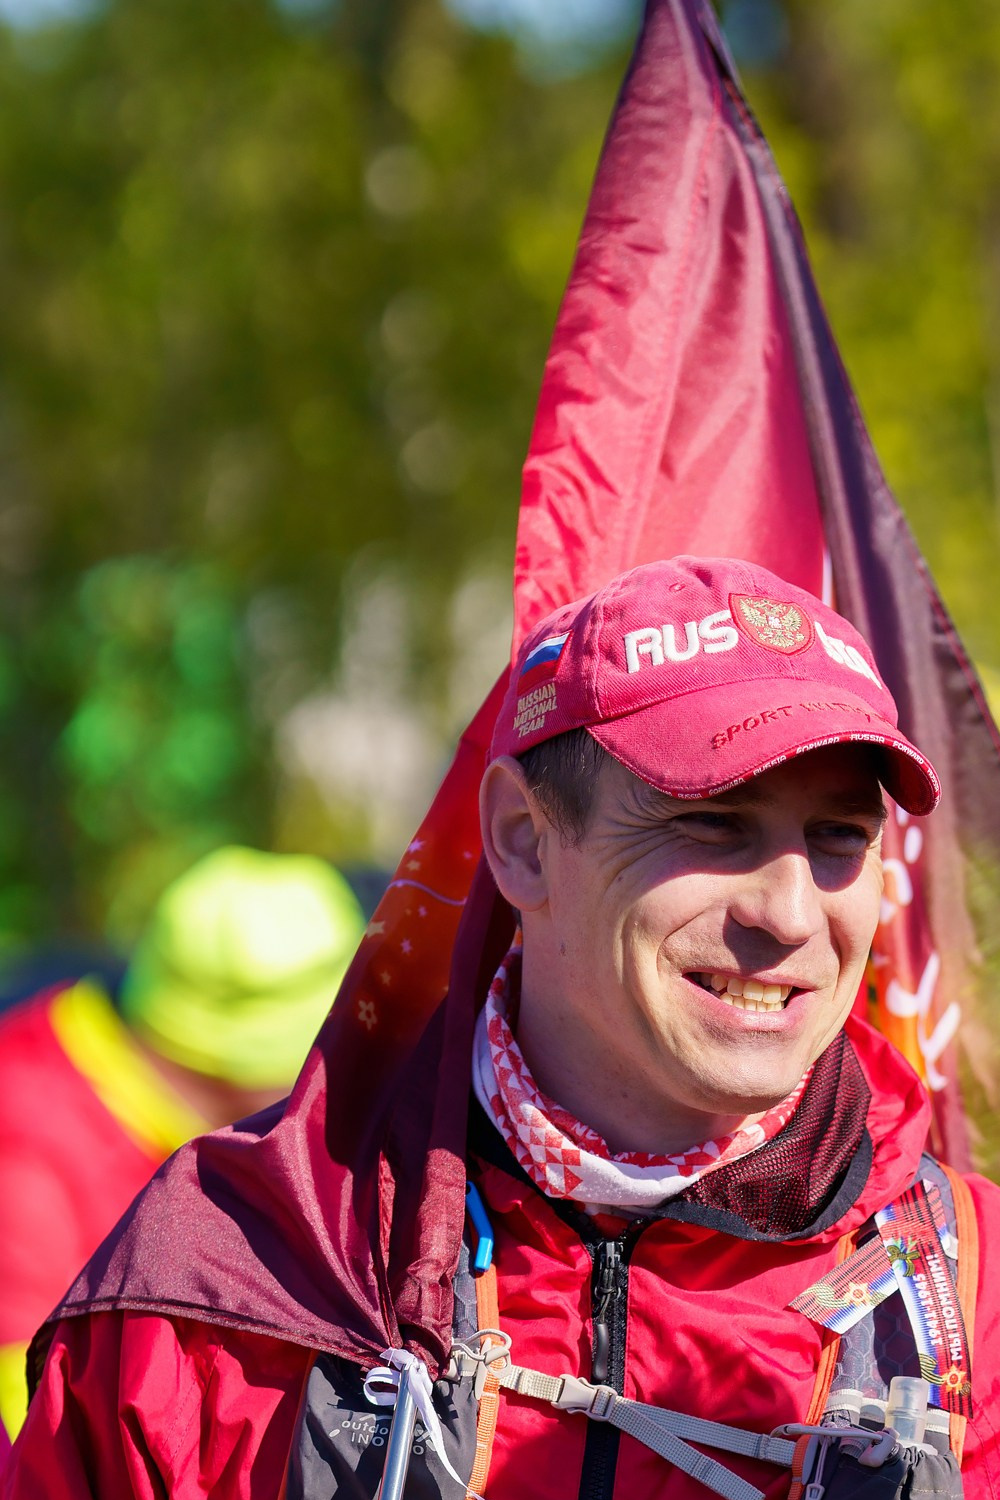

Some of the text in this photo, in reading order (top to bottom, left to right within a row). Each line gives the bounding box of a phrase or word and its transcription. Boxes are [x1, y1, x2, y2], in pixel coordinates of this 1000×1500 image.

[624, 609, 739, 674] RUS
[513, 696, 558, 730] NATIONAL
[517, 682, 557, 715] RUSSIAN
[518, 714, 546, 738] TEAM
[711, 704, 793, 750] SPORT
[708, 776, 746, 797] FORWARD
[753, 754, 787, 777] RUSSIA
[795, 736, 840, 755] FORWARD
[850, 733, 885, 744] RUSSIA
[892, 740, 925, 766] FORWARD
[913, 1273, 943, 1346] 1941-1945
[926, 1253, 963, 1361] МЫ ПОМНИМ!
